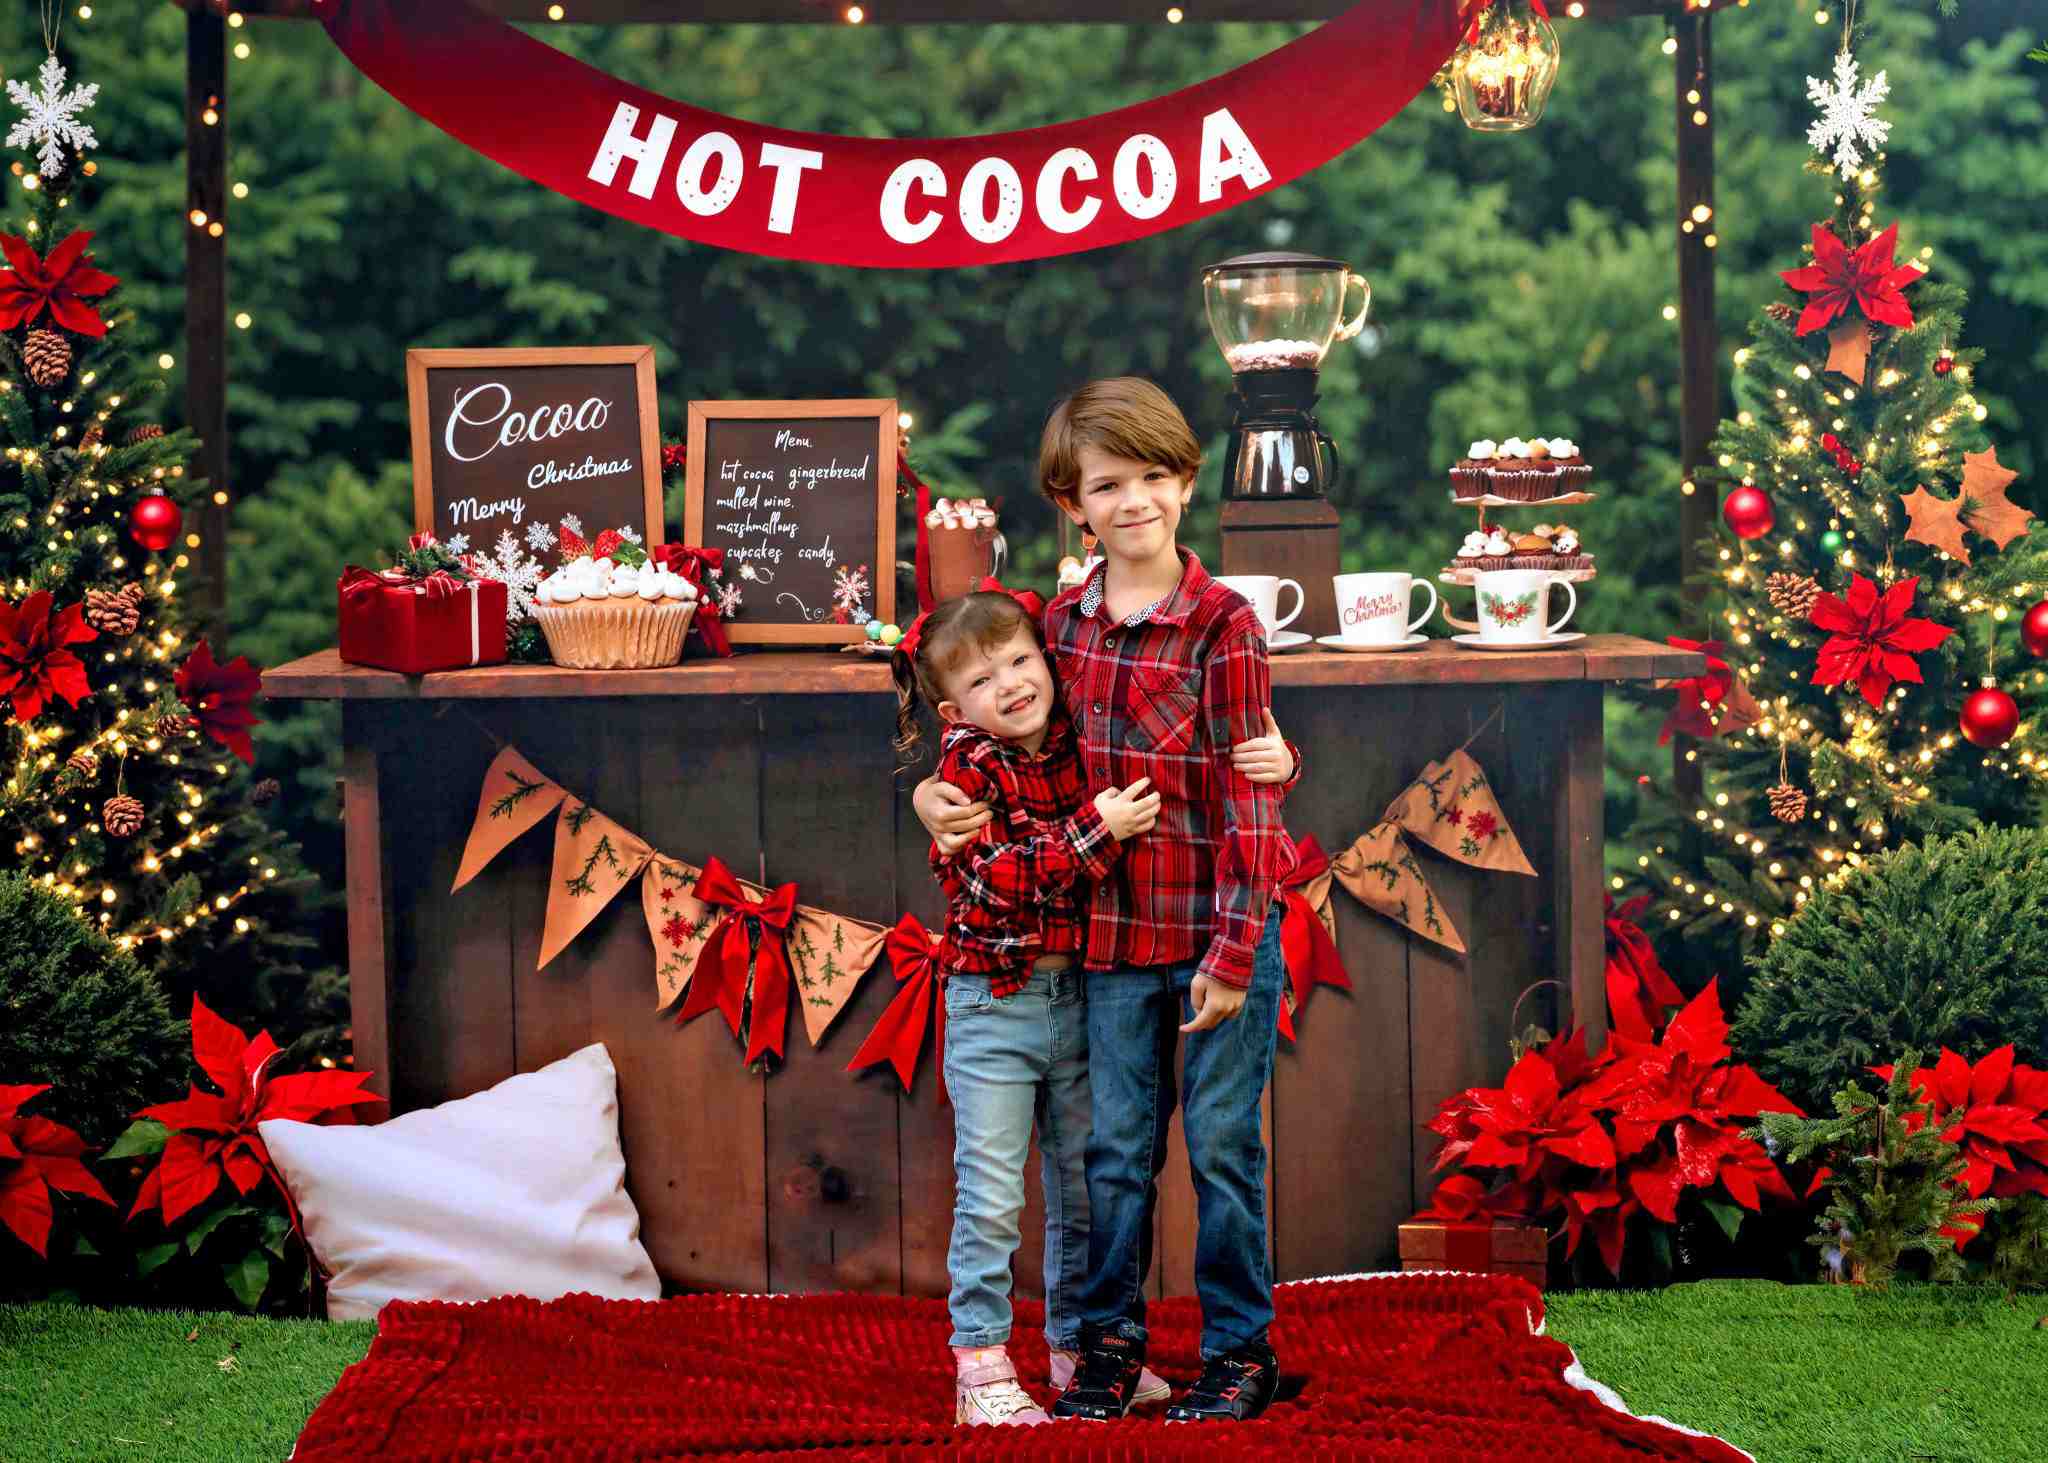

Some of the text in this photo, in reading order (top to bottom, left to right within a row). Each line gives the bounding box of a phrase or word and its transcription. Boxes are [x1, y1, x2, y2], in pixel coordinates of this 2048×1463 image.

[586, 101, 1272, 245] HOT COCOA
[445, 382, 613, 462] Cocoa
[527, 455, 633, 489] Christmas
[720, 454, 870, 490] hot cocoa gingerbread
[449, 497, 526, 526] Merry
[716, 484, 761, 510] mulled
[716, 511, 800, 538] marshmallows
[727, 538, 784, 564] cupcakes
[1355, 592, 1393, 610] Merry
